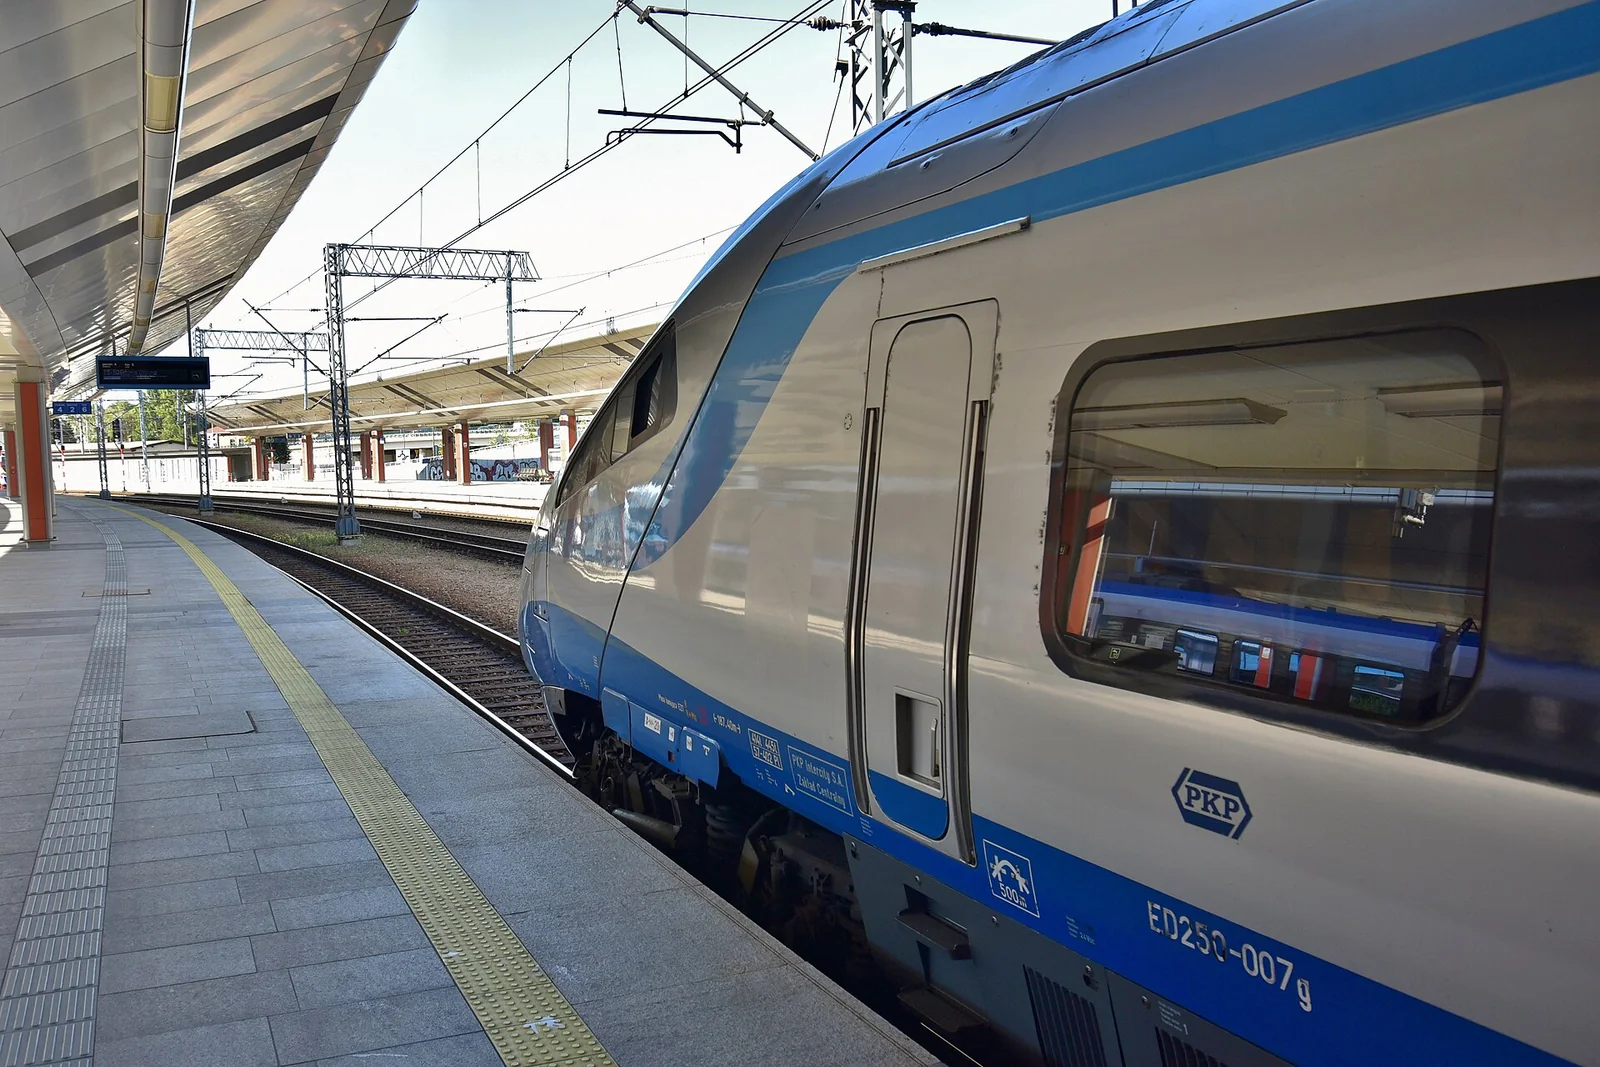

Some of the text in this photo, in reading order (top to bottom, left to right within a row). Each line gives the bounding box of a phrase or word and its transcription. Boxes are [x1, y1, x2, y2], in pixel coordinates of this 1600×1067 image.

[791, 754, 844, 787] PKP Intercity S.A.
[816, 782, 846, 810] Centralny
[1184, 783, 1240, 821] PKP
[1147, 900, 1313, 1013] ED250-007 g
